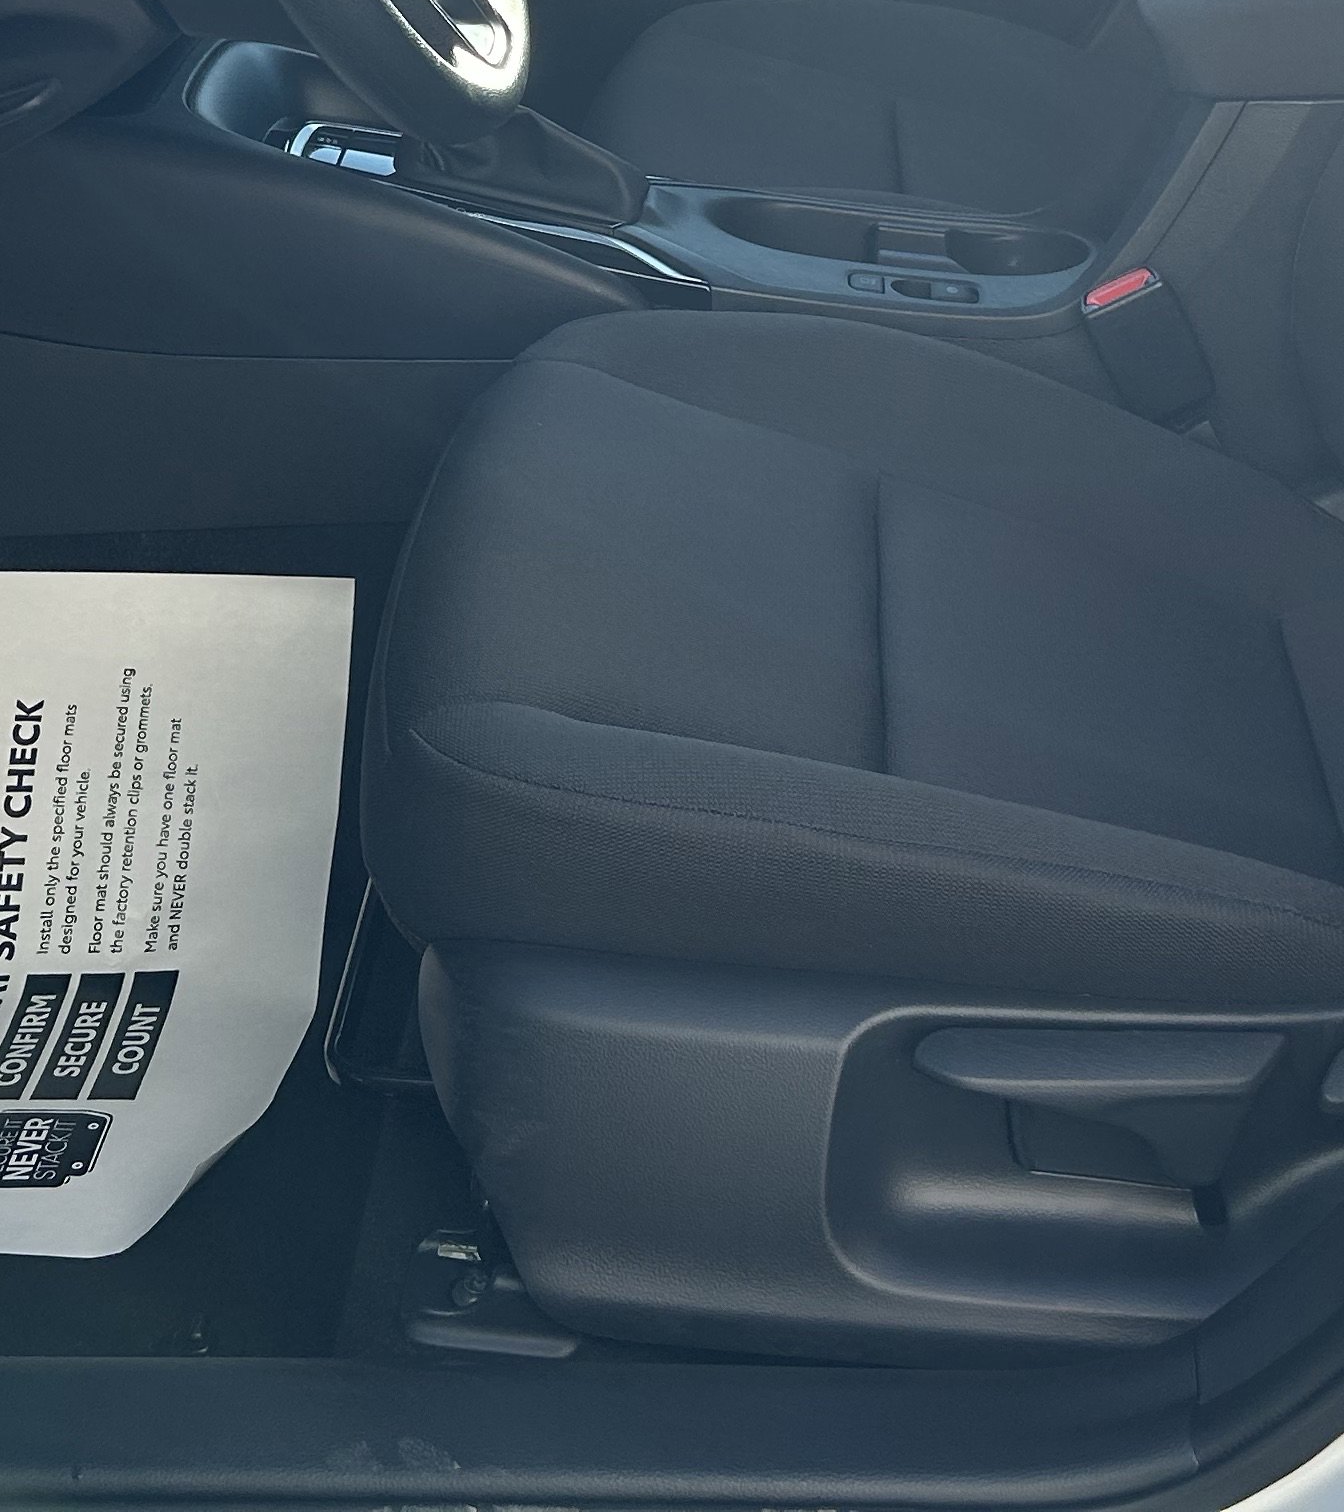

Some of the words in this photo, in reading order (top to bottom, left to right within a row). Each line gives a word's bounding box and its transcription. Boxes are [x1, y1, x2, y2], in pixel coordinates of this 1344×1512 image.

[119, 668, 136, 703] using
[65, 703, 78, 736] mats
[114, 706, 129, 758] secured
[136, 683, 154, 753] grommets.
[170, 717, 182, 744] mat
[3, 699, 45, 818] CHECK
[56, 740, 73, 773] floor
[107, 761, 122, 779] be
[134, 755, 144, 771] or
[163, 747, 178, 780] floor
[76, 768, 91, 820] vehicle.
[105, 782, 123, 828] always
[126, 774, 143, 806] clips
[164, 783, 175, 810] one
[184, 778, 197, 815] stack
[52, 776, 68, 842] specified
[72, 824, 85, 858] your
[122, 808, 138, 872] retention
[156, 813, 172, 847] have
[177, 819, 193, 870] double
[47, 846, 61, 872] the
[66, 859, 80, 882] for
[97, 832, 113, 881] should
[156, 852, 169, 879] you
[45, 874, 60, 906] only
[95, 883, 108, 912] mat
[116, 874, 134, 925] factory
[153, 881, 165, 912] sure
[169, 874, 187, 920] NEVER
[36, 910, 54, 955] Install
[58, 885, 78, 955] designed
[88, 916, 104, 954] Floor
[144, 915, 161, 953] Make
[168, 923, 181, 951] and
[110, 930, 125, 954] the
[53, 1000, 108, 1078] SECURE
[111, 1003, 161, 1075] COUNT
[4, 1118, 23, 1129] IT
[1, 1117, 54, 1181] NEVER
[33, 1133, 72, 1180] STACK
[53, 1118, 77, 1131] IT
